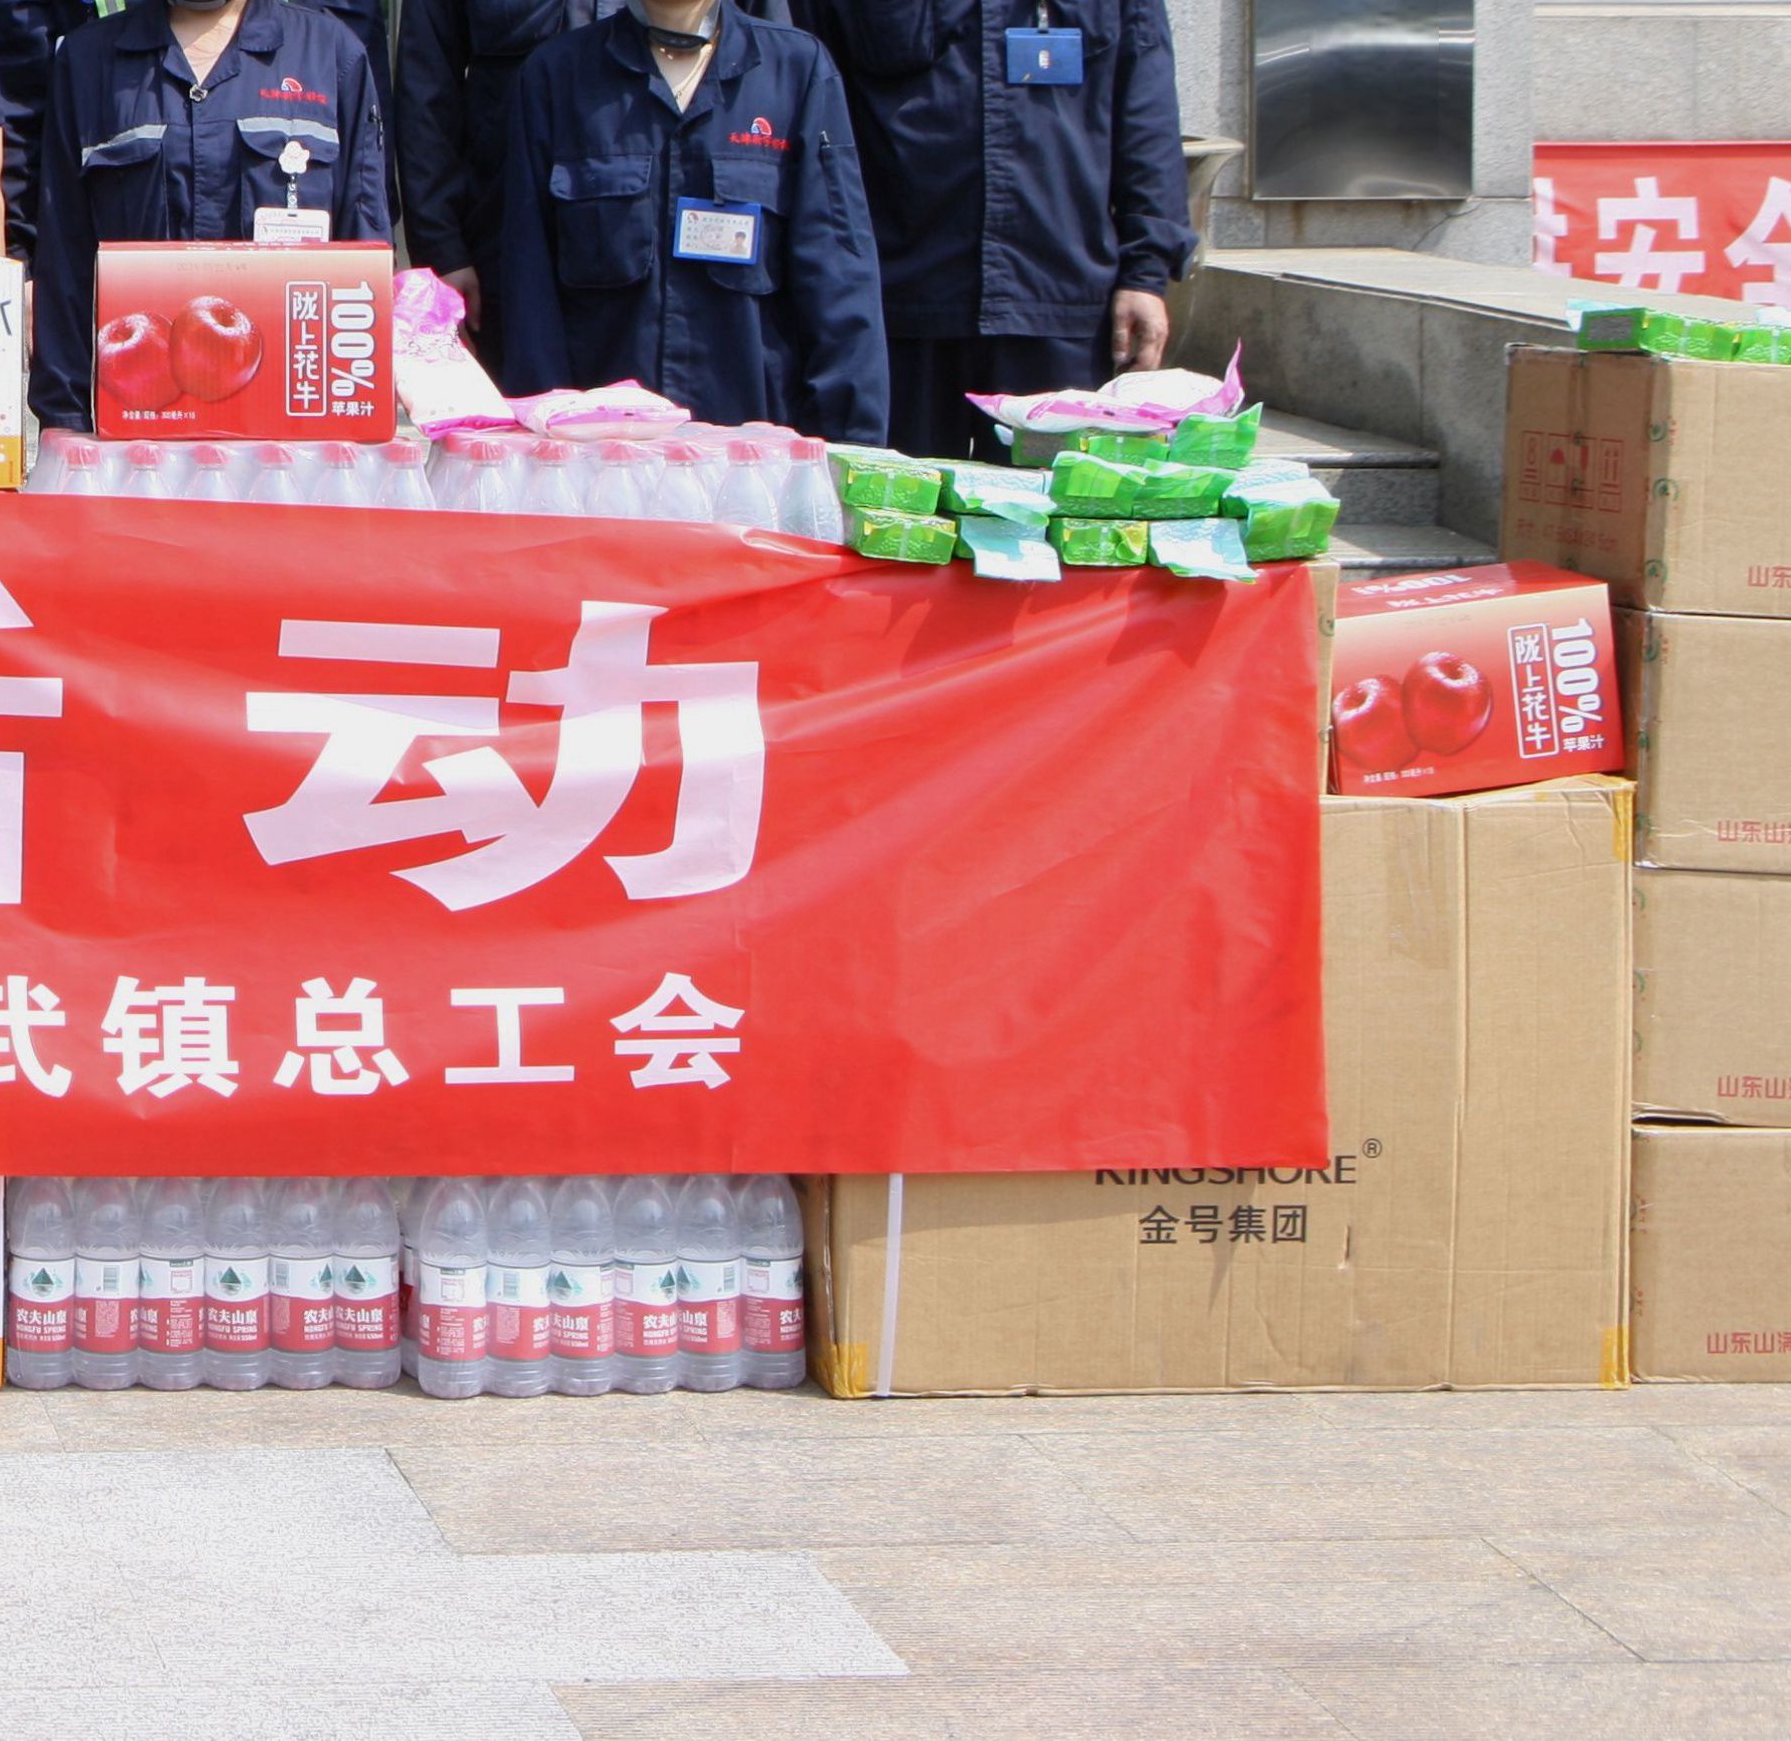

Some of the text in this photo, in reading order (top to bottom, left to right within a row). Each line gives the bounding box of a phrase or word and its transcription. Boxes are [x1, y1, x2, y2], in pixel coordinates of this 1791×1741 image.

[291, 291, 320, 410] 陇上花牛
[330, 280, 376, 398] 100%
[1515, 633, 1551, 750] 陇上花牛
[1551, 617, 1603, 734] 100%
[1717, 819, 1791, 845] 山东山
[1717, 1075, 1791, 1100] 山东山
[1138, 1204, 1308, 1244] 金号集团
